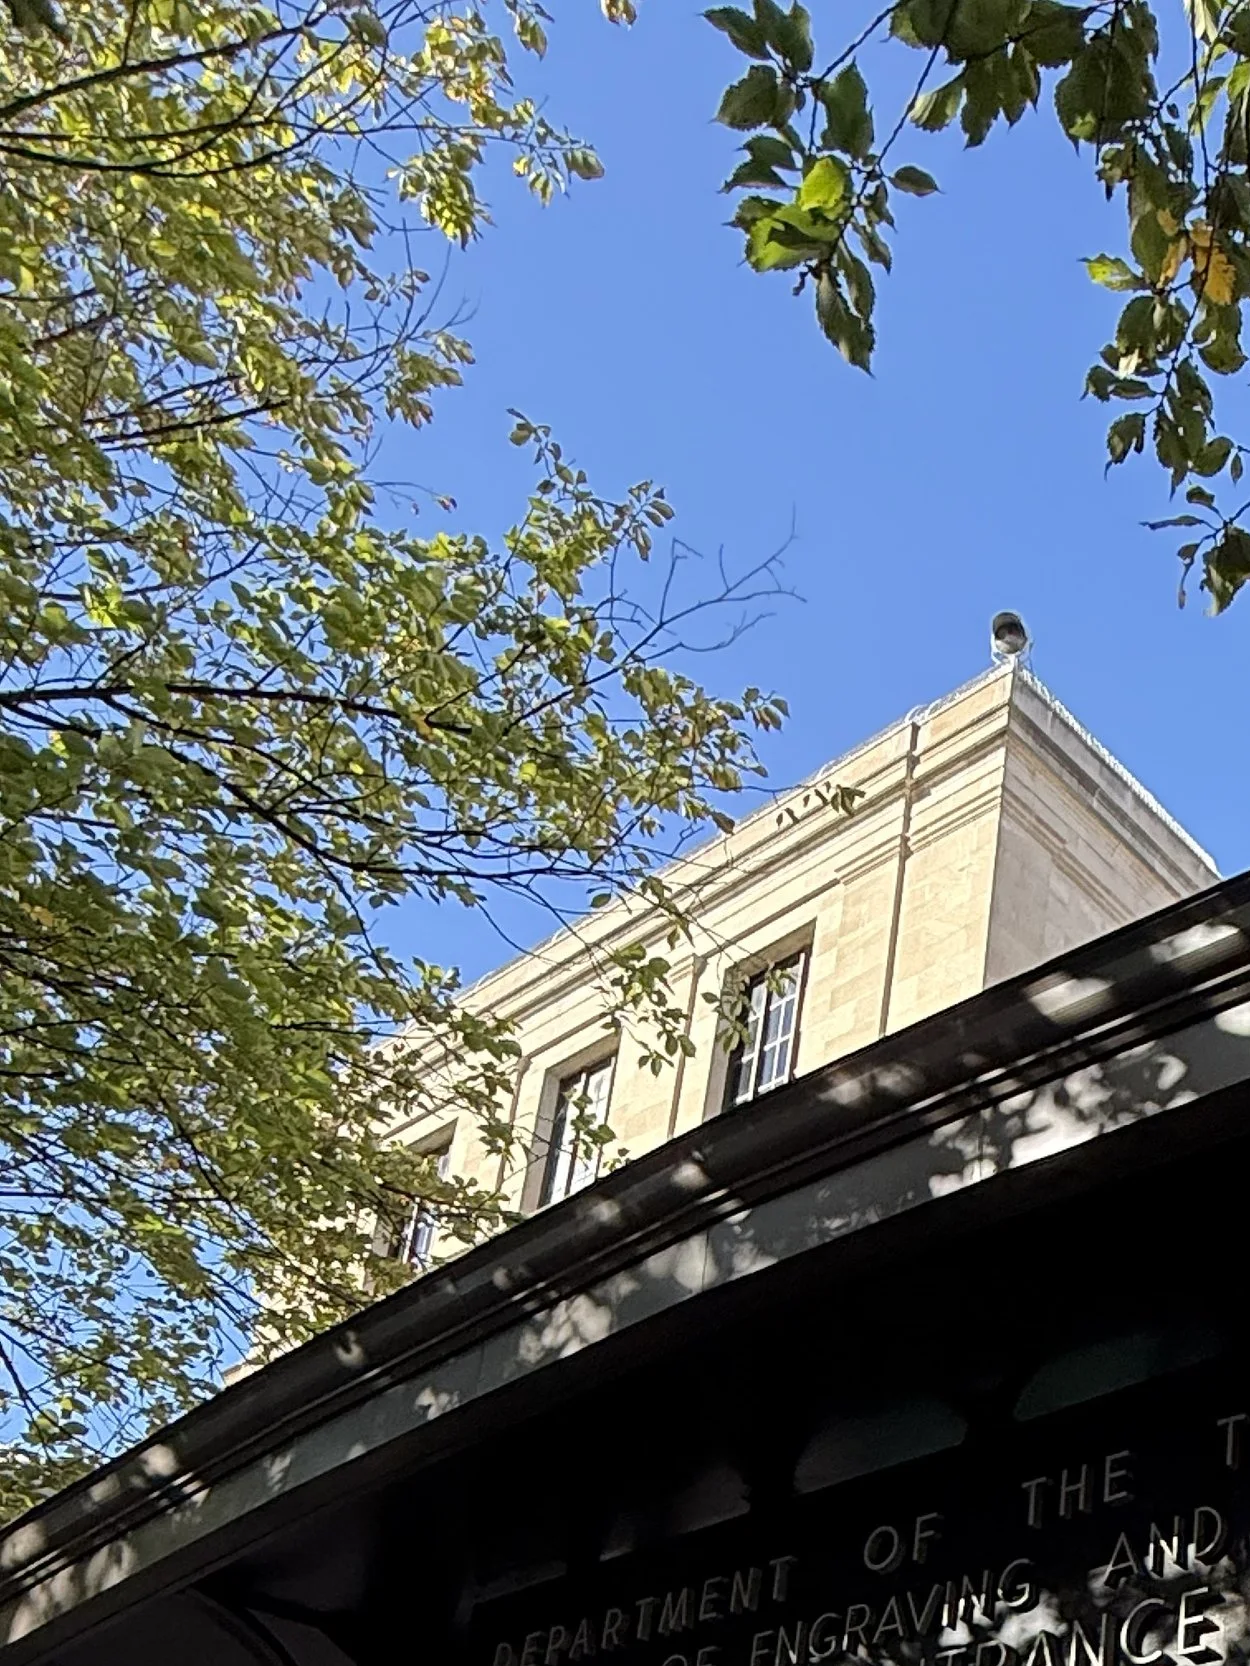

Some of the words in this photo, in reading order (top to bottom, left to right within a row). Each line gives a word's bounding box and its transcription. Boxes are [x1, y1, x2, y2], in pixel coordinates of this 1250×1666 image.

[864, 1512, 938, 1571] OF
[1021, 1450, 1131, 1526] THE
[1103, 1506, 1222, 1587] AND
